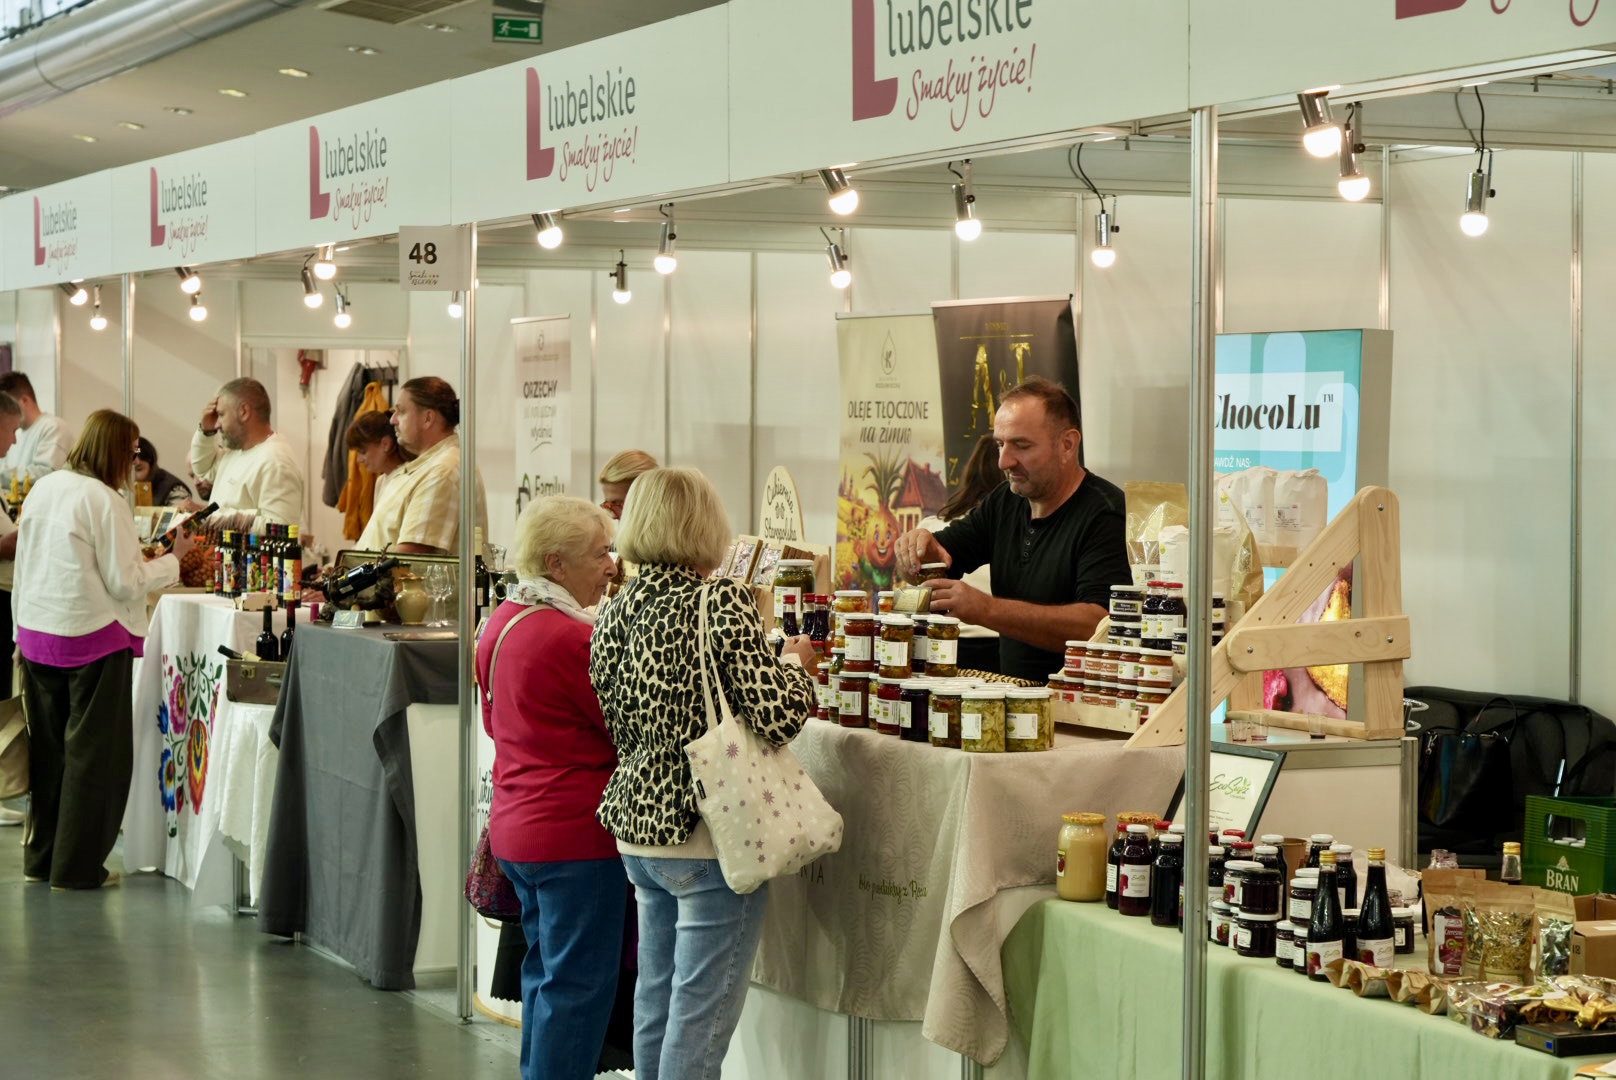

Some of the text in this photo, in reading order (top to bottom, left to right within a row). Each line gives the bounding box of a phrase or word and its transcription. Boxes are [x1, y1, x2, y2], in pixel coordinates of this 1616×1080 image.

[548, 65, 636, 132] lubelskie
[906, 43, 1036, 132] Smakuj życie!
[324, 128, 388, 179] lubelskie
[559, 126, 638, 193] Smakuj życie!
[161, 172, 208, 213] lubelskie
[333, 176, 389, 231] Smakuj życie!
[42, 200, 77, 237] lubelskie
[408, 242, 438, 265] 48
[523, 379, 558, 399] ORZECHY
[847, 400, 929, 421] OLEJE TŁOCZONE
[859, 421, 912, 444] na zimno
[1214, 455, 1235, 468] AWDŹ
[1545, 868, 1580, 893] BRAN
